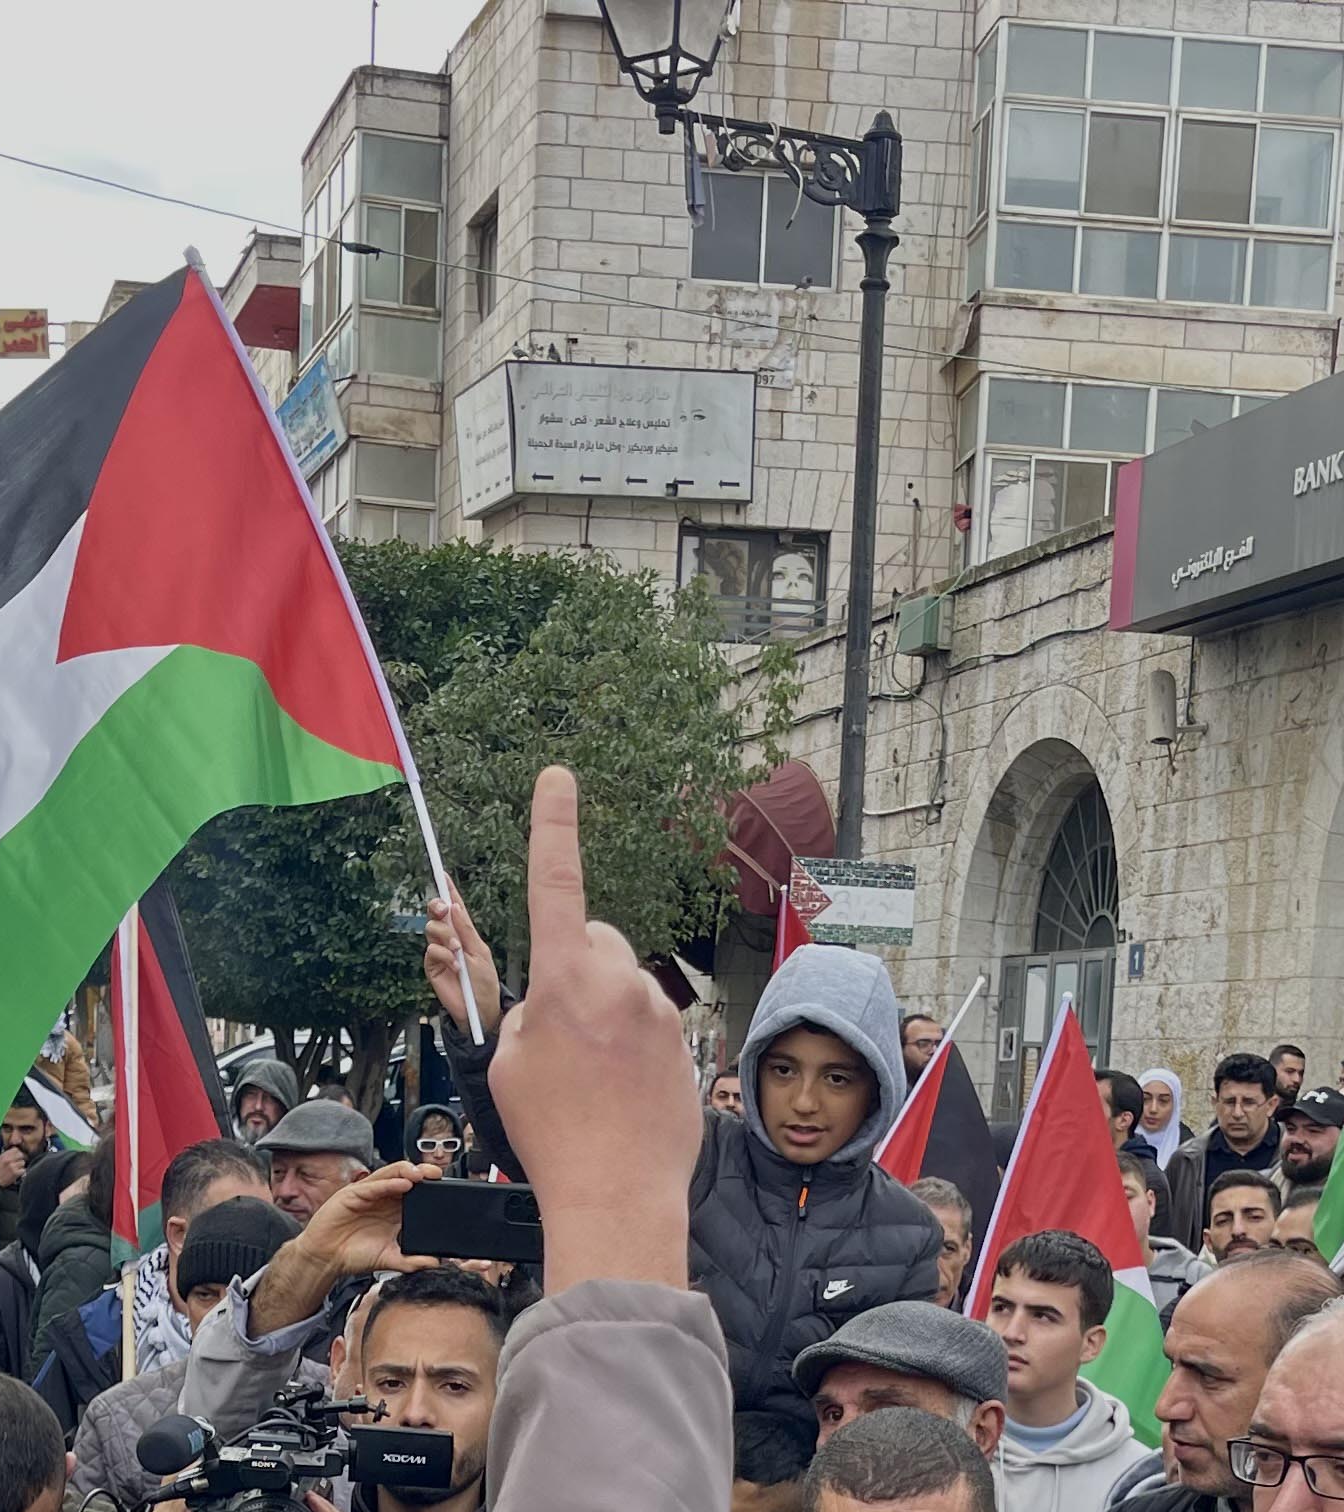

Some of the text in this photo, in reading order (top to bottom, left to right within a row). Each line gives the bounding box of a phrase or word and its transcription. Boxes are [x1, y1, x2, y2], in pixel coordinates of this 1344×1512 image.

[593, 414, 617, 428] الشعر
[1293, 450, 1344, 496] BANK
[1223, 536, 1254, 571] الفرع
[1134, 951, 1140, 971] 1
